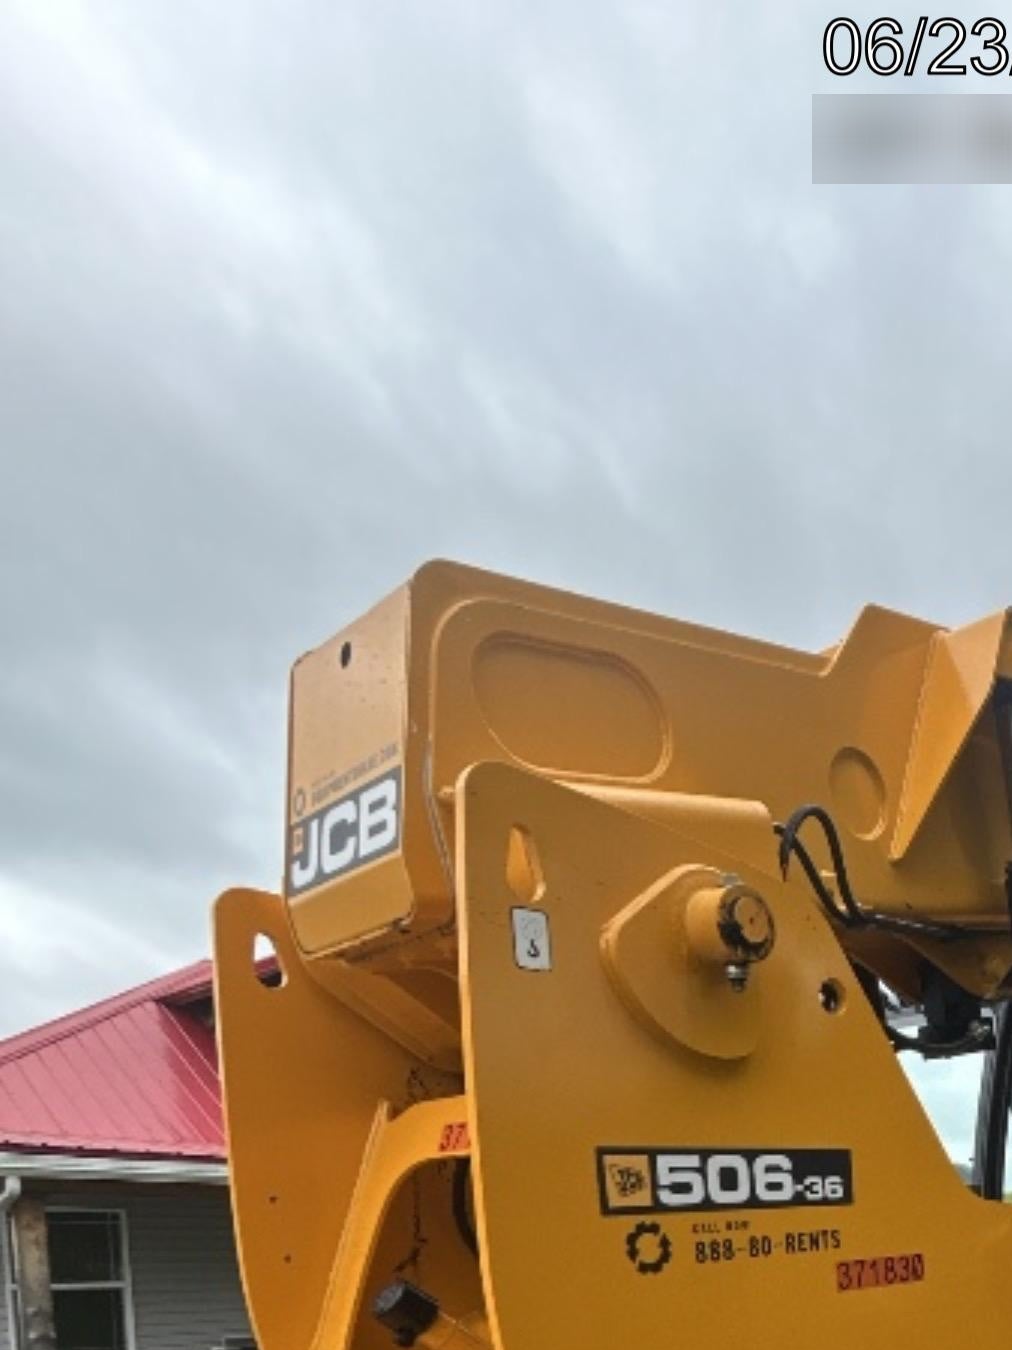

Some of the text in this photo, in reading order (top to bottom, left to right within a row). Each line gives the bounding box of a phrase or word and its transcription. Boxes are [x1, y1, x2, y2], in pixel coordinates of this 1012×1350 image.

[290, 777, 398, 889] JCB
[655, 1154, 845, 1206] 506-36
[836, 1252, 925, 1292] 371830
